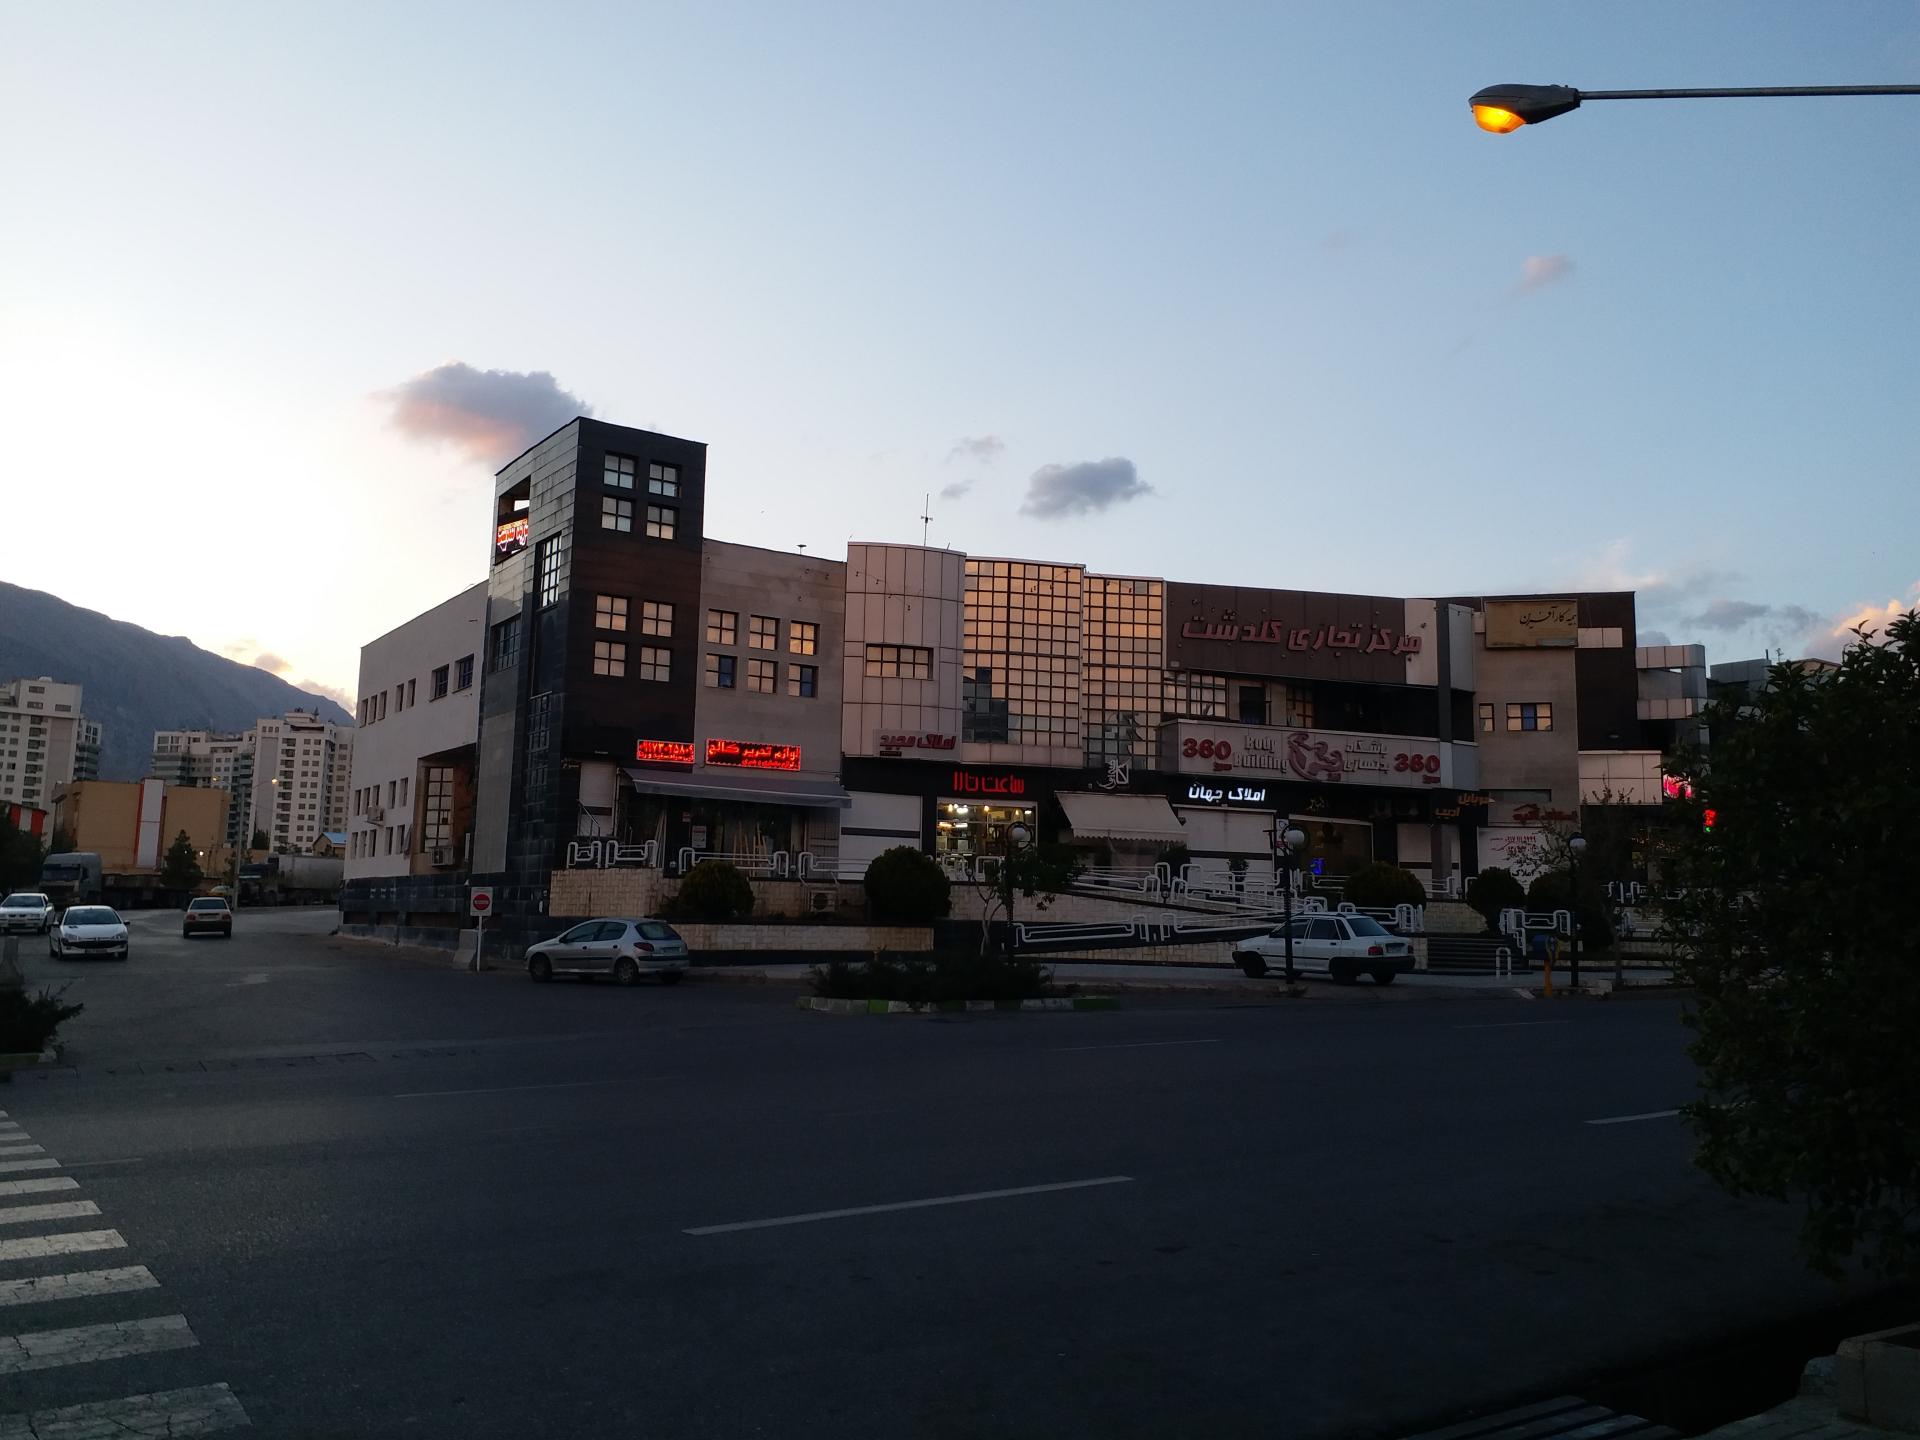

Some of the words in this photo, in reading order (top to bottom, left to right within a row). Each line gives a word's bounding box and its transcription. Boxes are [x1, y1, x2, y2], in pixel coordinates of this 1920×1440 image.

[1565, 613, 1577, 627] بیمه
[1288, 623, 1362, 655] تجاری
[1364, 625, 1422, 655] مرکز
[880, 735, 916, 751] مجید
[917, 733, 957, 750] املاک
[1183, 737, 1232, 760] 360
[1345, 740, 1388, 758] باشگاه
[743, 747, 772, 757] تحریر
[774, 747, 799, 760] لوازم
[1232, 751, 1288, 774] Building
[1394, 753, 1441, 774] 360
[982, 773, 1025, 794] ساعت
[1187, 782, 1224, 802] جهان
[1227, 788, 1267, 802] املاک
